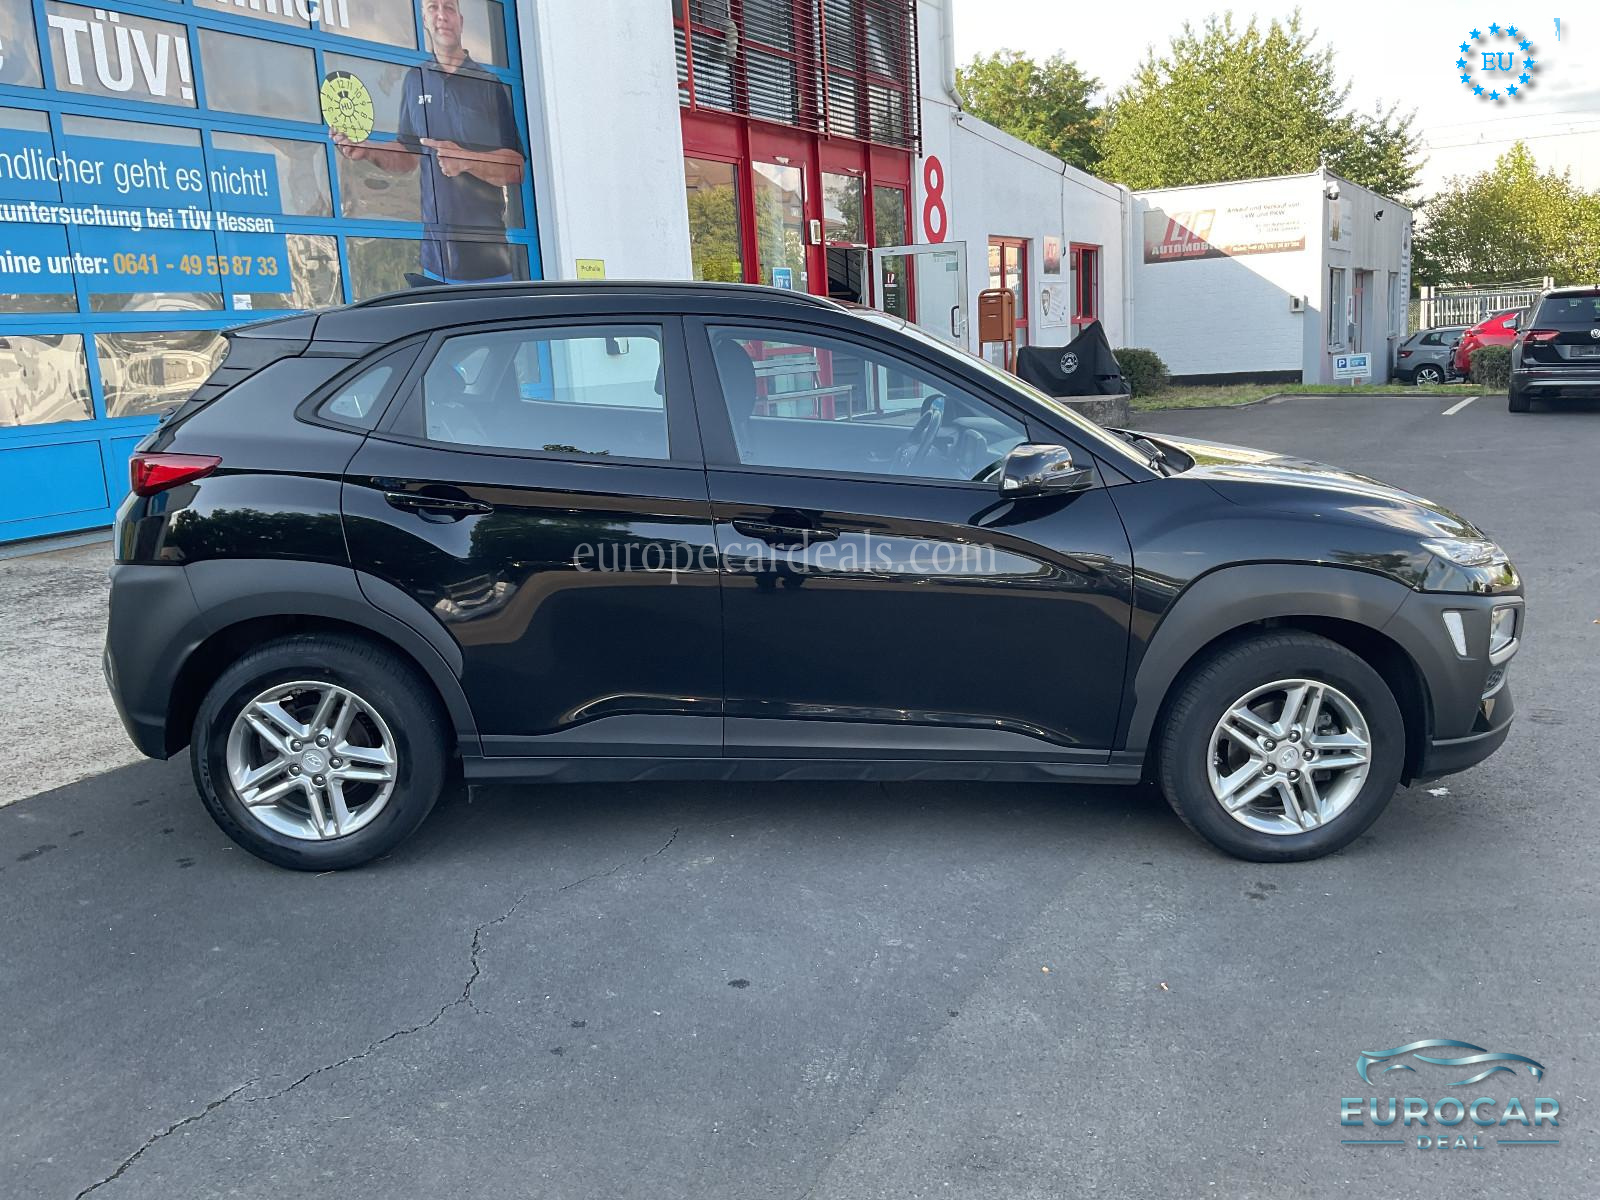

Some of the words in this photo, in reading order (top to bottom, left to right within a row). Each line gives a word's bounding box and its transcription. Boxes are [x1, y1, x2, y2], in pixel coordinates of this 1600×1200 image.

[48, 9, 194, 100] TÜV!
[341, 101, 352, 110] HU
[113, 159, 170, 194] geht
[176, 167, 202, 192] es
[210, 165, 268, 197] nicht!
[924, 155, 947, 244] 8
[147, 207, 174, 229] bei
[177, 205, 212, 230] TÜV
[217, 211, 275, 233] Hessen
[47, 251, 109, 275] unter:
[113, 252, 158, 275] 0641
[179, 254, 202, 275] 49
[207, 255, 229, 276] 55
[232, 255, 252, 276] 87
[257, 257, 279, 277] 33
